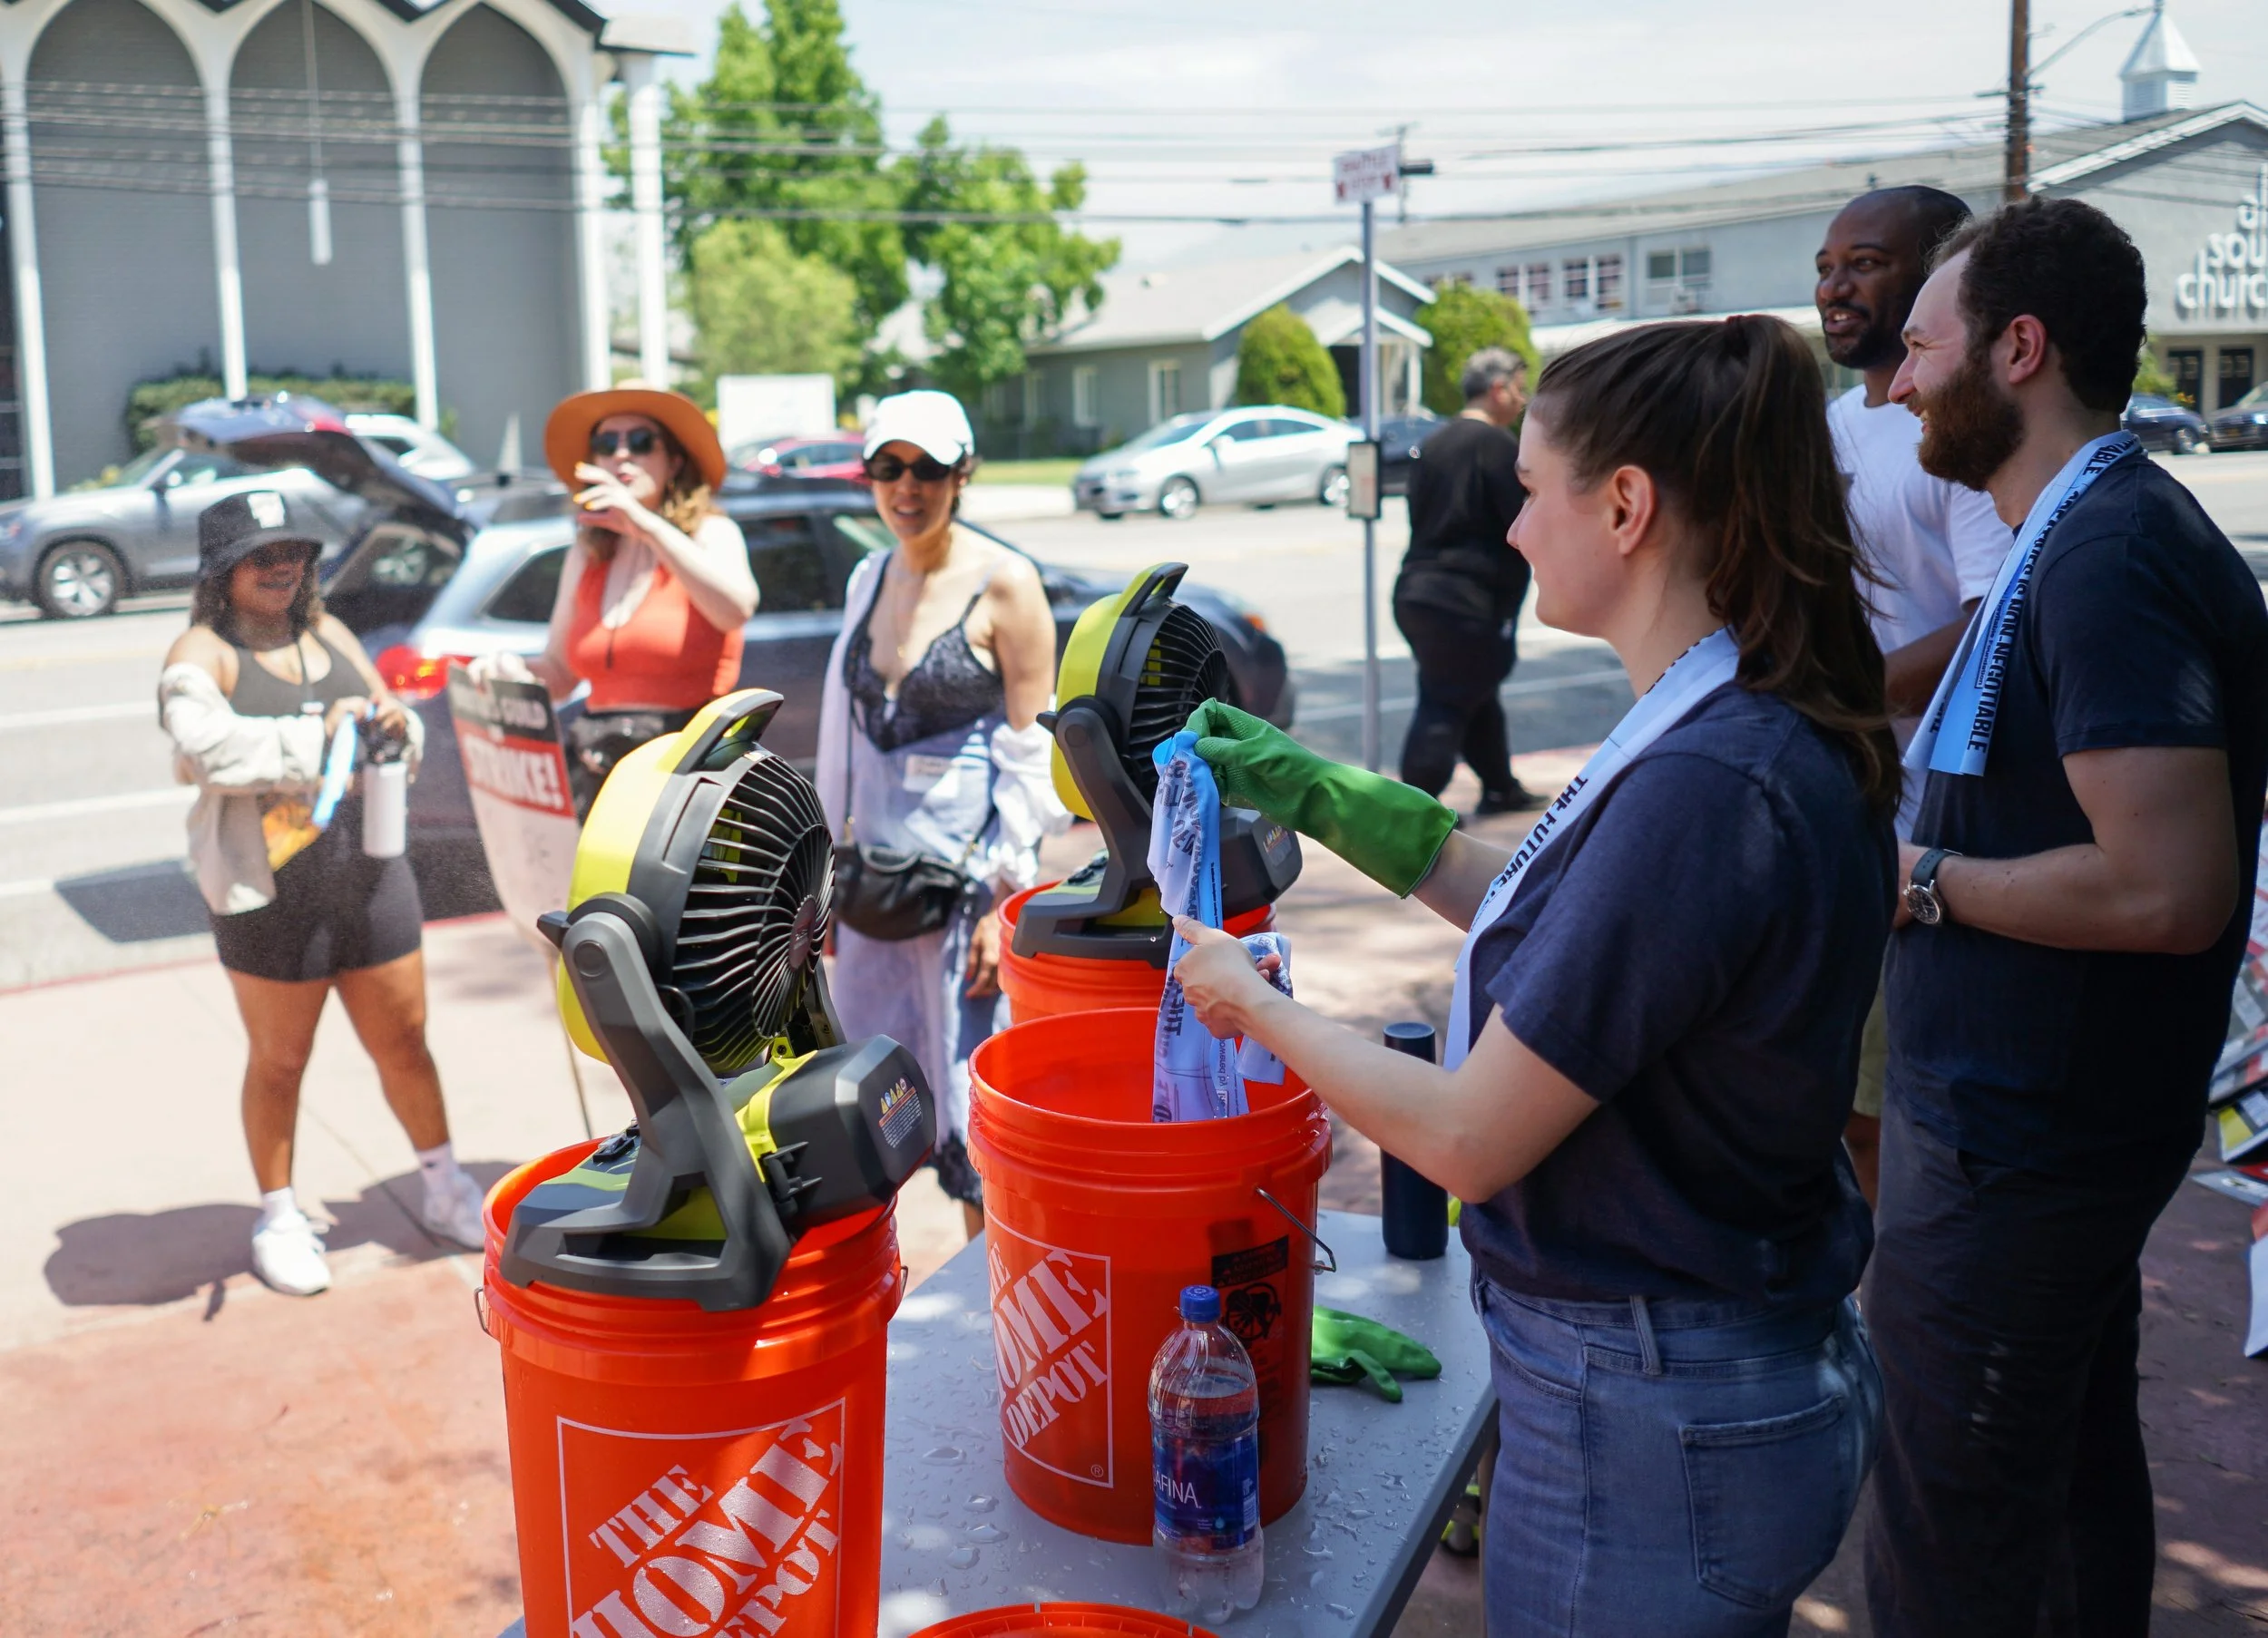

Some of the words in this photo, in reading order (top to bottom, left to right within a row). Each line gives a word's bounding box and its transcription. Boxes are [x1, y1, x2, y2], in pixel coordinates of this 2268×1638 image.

[1551, 775, 1589, 812] THE
[1496, 811, 1557, 888] FUTURE
[993, 1249, 1108, 1405] OME
[1006, 1340, 1108, 1448] DEPOT
[588, 1464, 715, 1569] THE
[1155, 1469, 1199, 1508] AFINA
